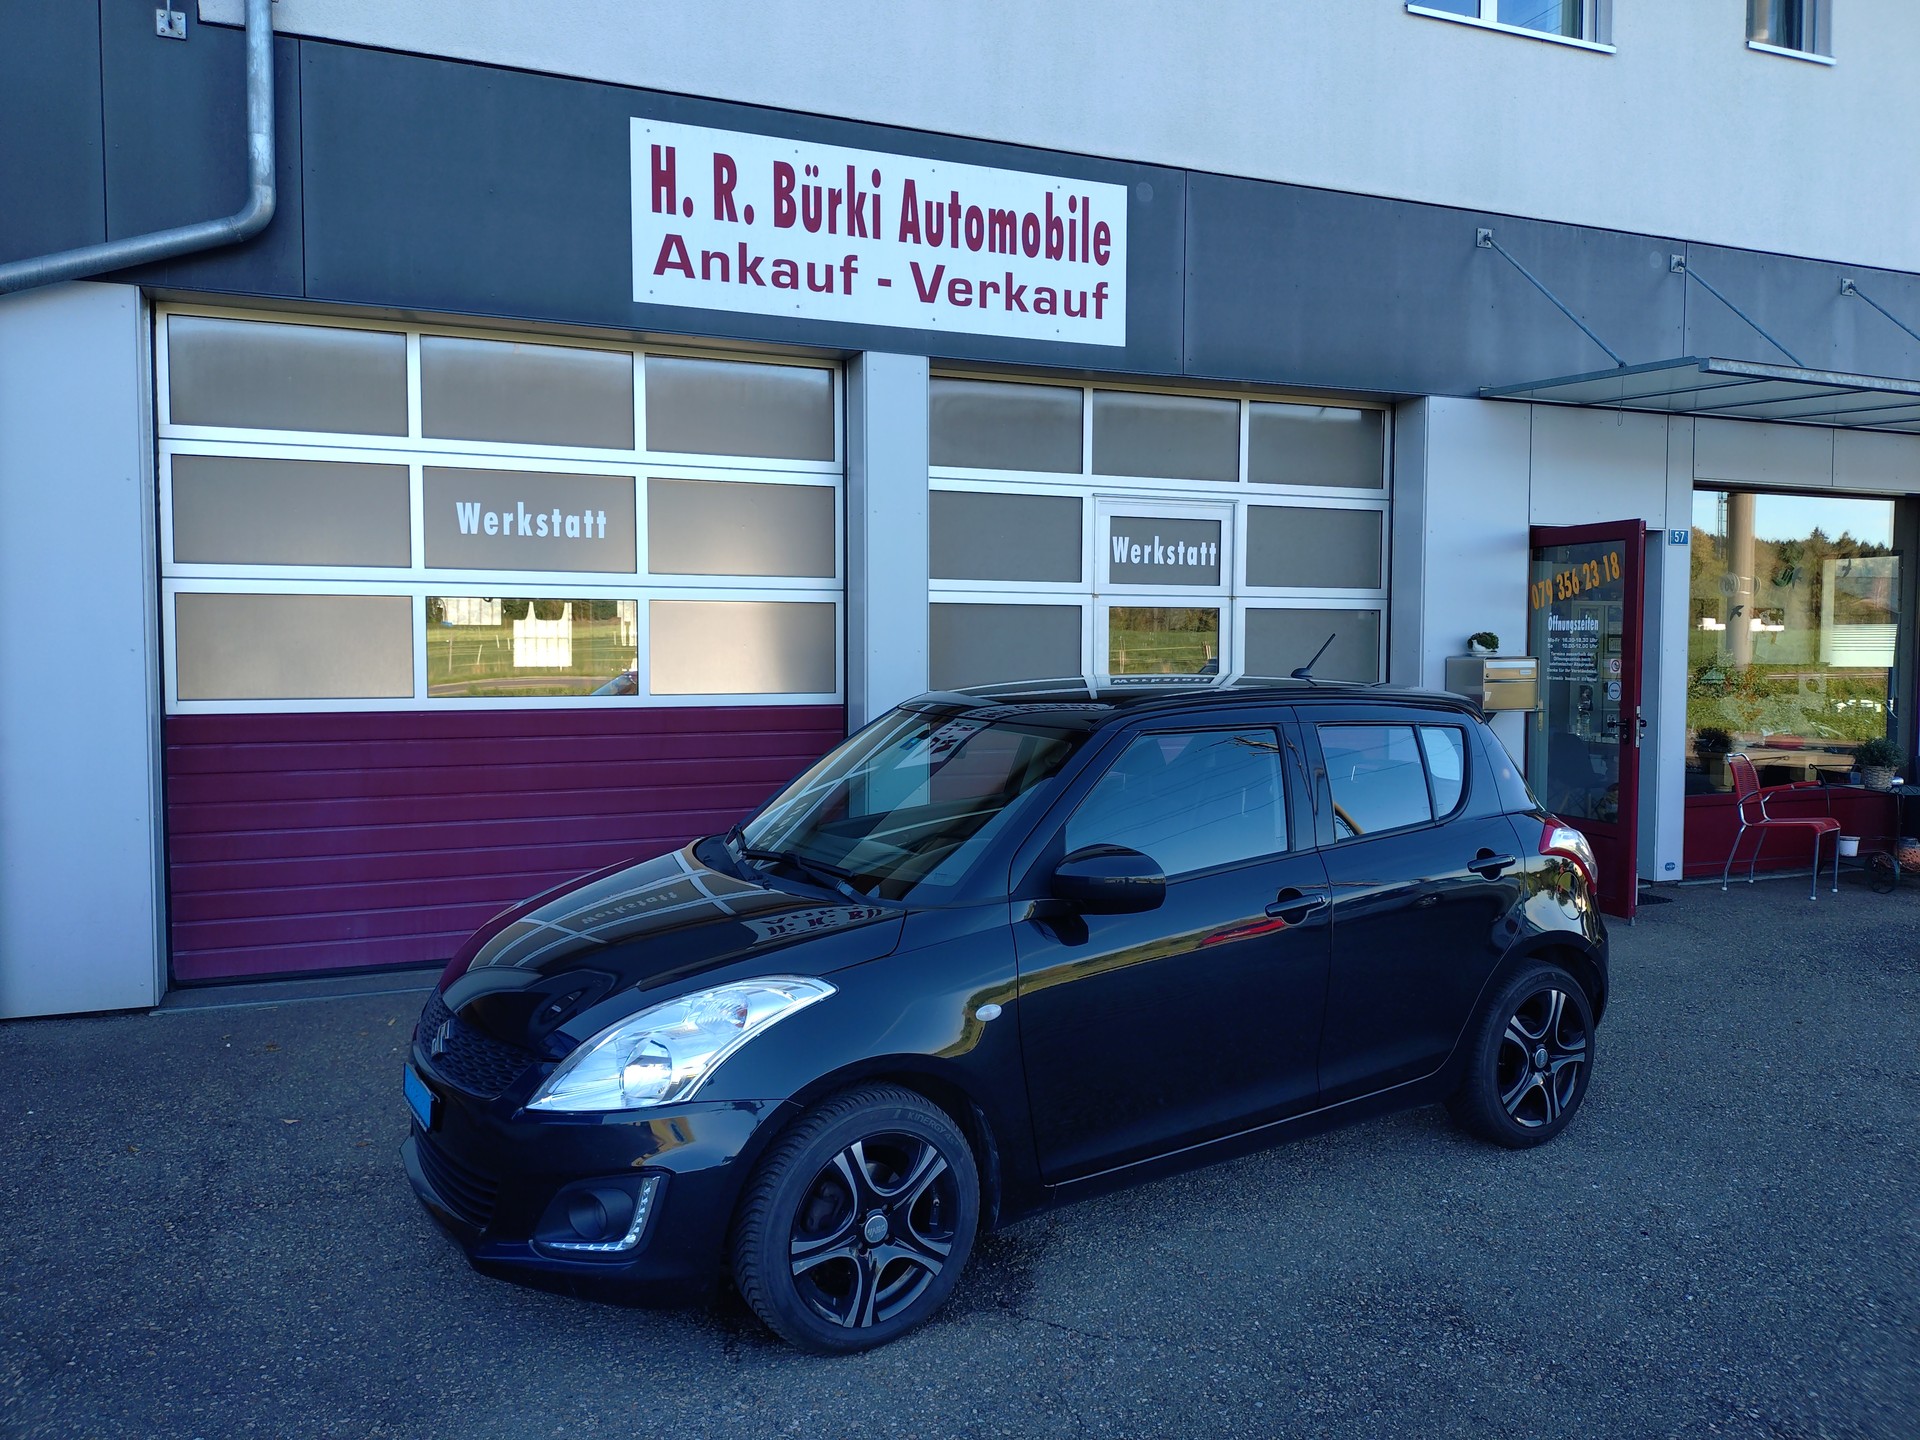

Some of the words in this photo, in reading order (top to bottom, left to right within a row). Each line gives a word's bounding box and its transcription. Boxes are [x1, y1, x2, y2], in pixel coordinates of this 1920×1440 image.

[651, 144, 694, 219] H.
[713, 152, 755, 226] R.
[773, 160, 881, 240] Bürki
[898, 178, 1111, 266] Automobile
[653, 233, 858, 296] Ankauf
[877, 277, 892, 288] -
[910, 261, 1109, 320] Verkauf
[456, 501, 606, 538] Werkstatt
[1674, 531, 1685, 543] 57
[1112, 535, 1217, 566] Werkstatt
[1531, 579, 1553, 610] 079
[1556, 568, 1580, 601] 356
[1582, 559, 1600, 591] 23
[1603, 551, 1620, 583] 18
[1547, 612, 1599, 634] Öffnungszeiten
